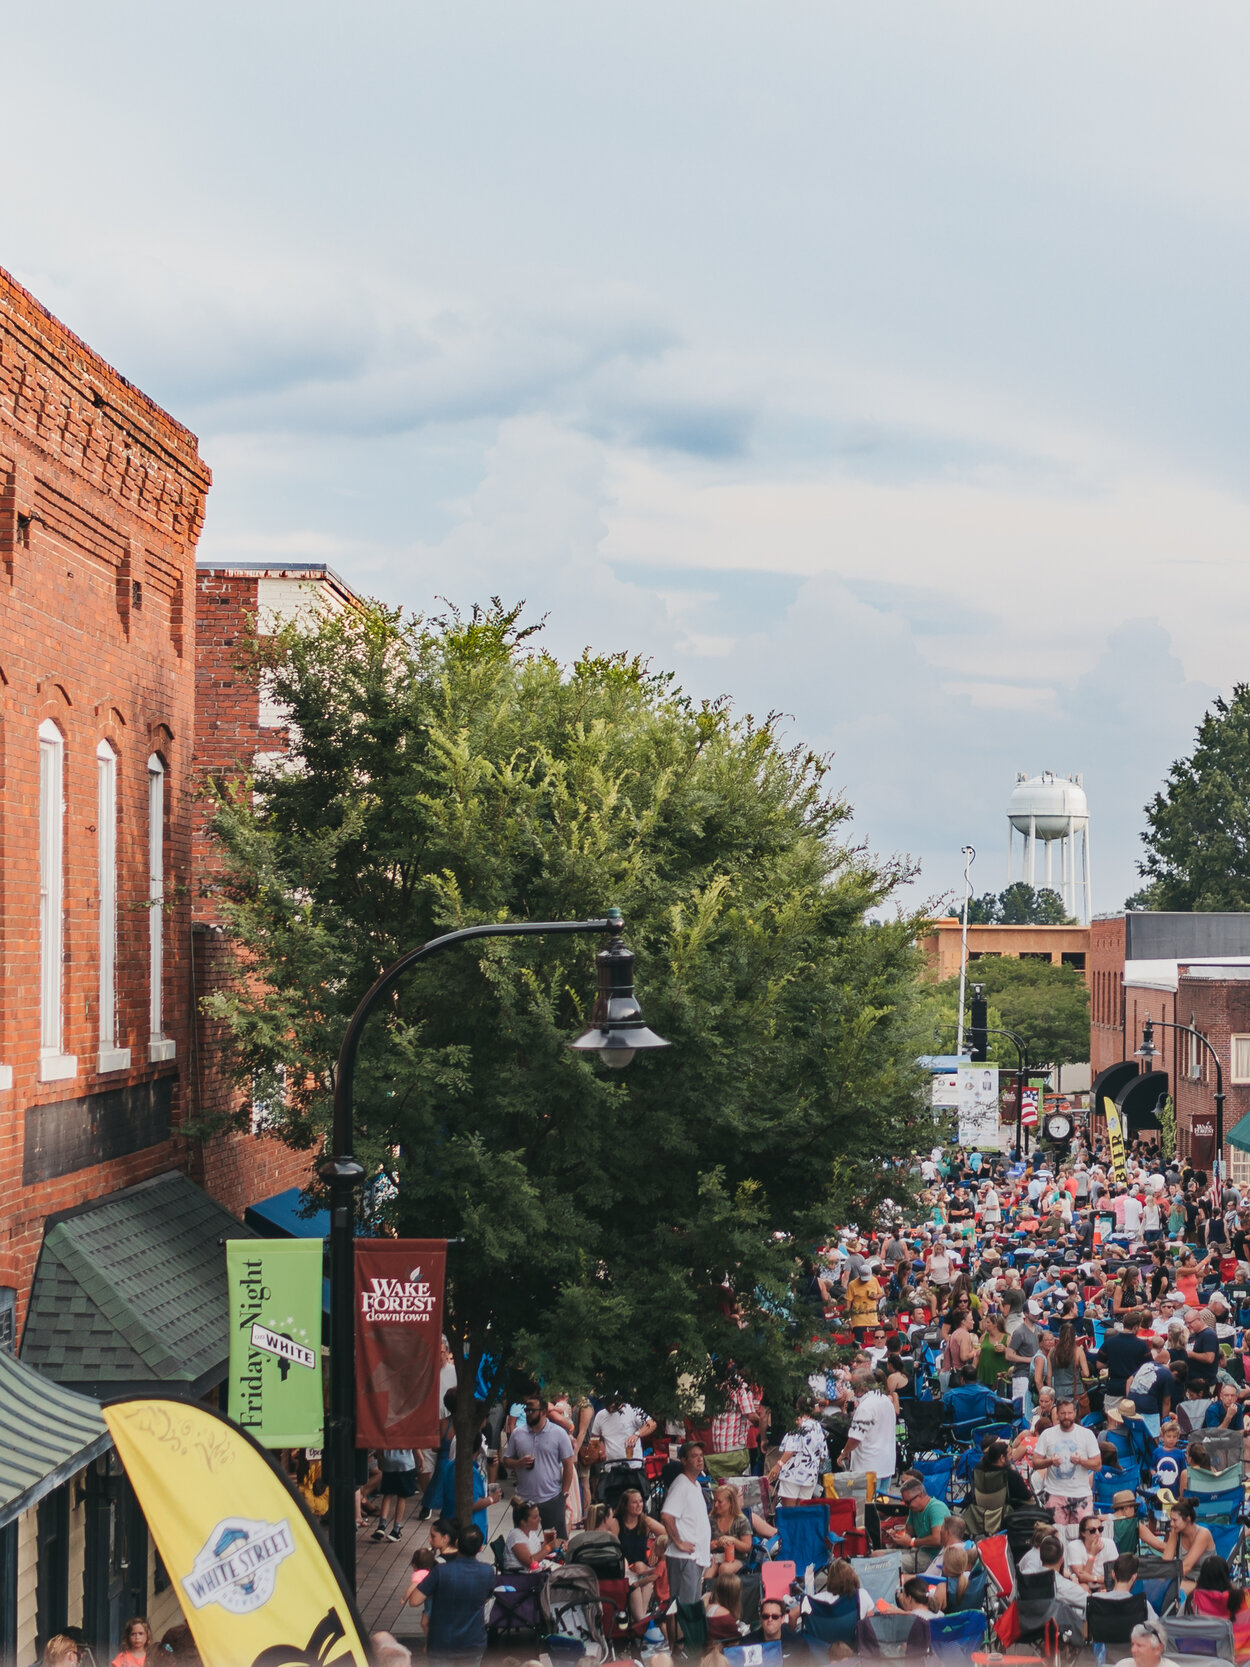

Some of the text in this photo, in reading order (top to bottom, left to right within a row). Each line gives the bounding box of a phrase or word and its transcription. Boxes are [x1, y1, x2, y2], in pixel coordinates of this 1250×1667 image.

[239, 1258, 272, 1331] Night
[361, 1291, 436, 1312] FOREST
[370, 1278, 431, 1298] WAKE
[365, 1310, 430, 1322] downtown
[265, 1333, 313, 1364] WHITE
[239, 1347, 272, 1430] Friday
[190, 1528, 290, 1599] WHITE STREET
